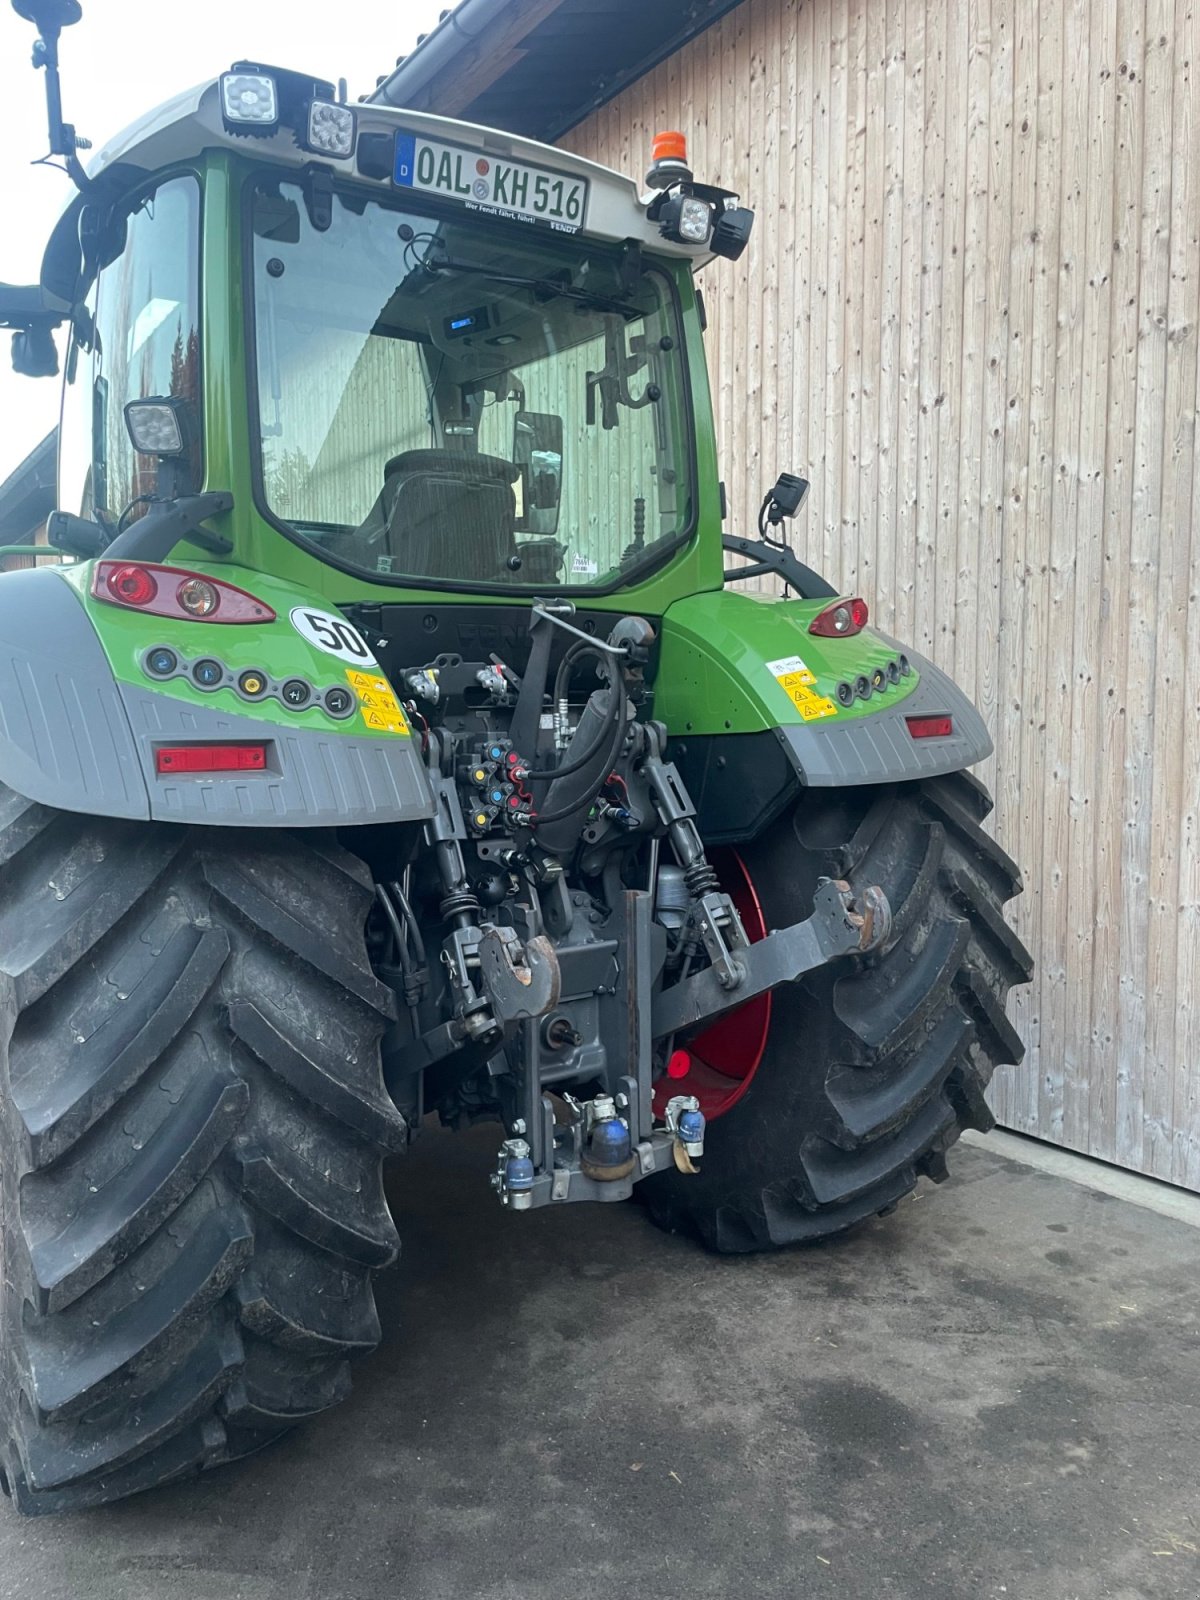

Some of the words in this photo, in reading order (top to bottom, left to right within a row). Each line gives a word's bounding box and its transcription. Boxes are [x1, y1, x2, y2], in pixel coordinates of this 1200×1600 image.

[400, 164, 408, 177] D
[416, 145, 471, 195] OAL
[492, 163, 529, 208] KH
[533, 175, 581, 221] 516
[464, 201, 478, 211] Wer
[479, 203, 498, 215] Fendt
[550, 220, 578, 235] FENDT
[303, 612, 368, 657] 50
